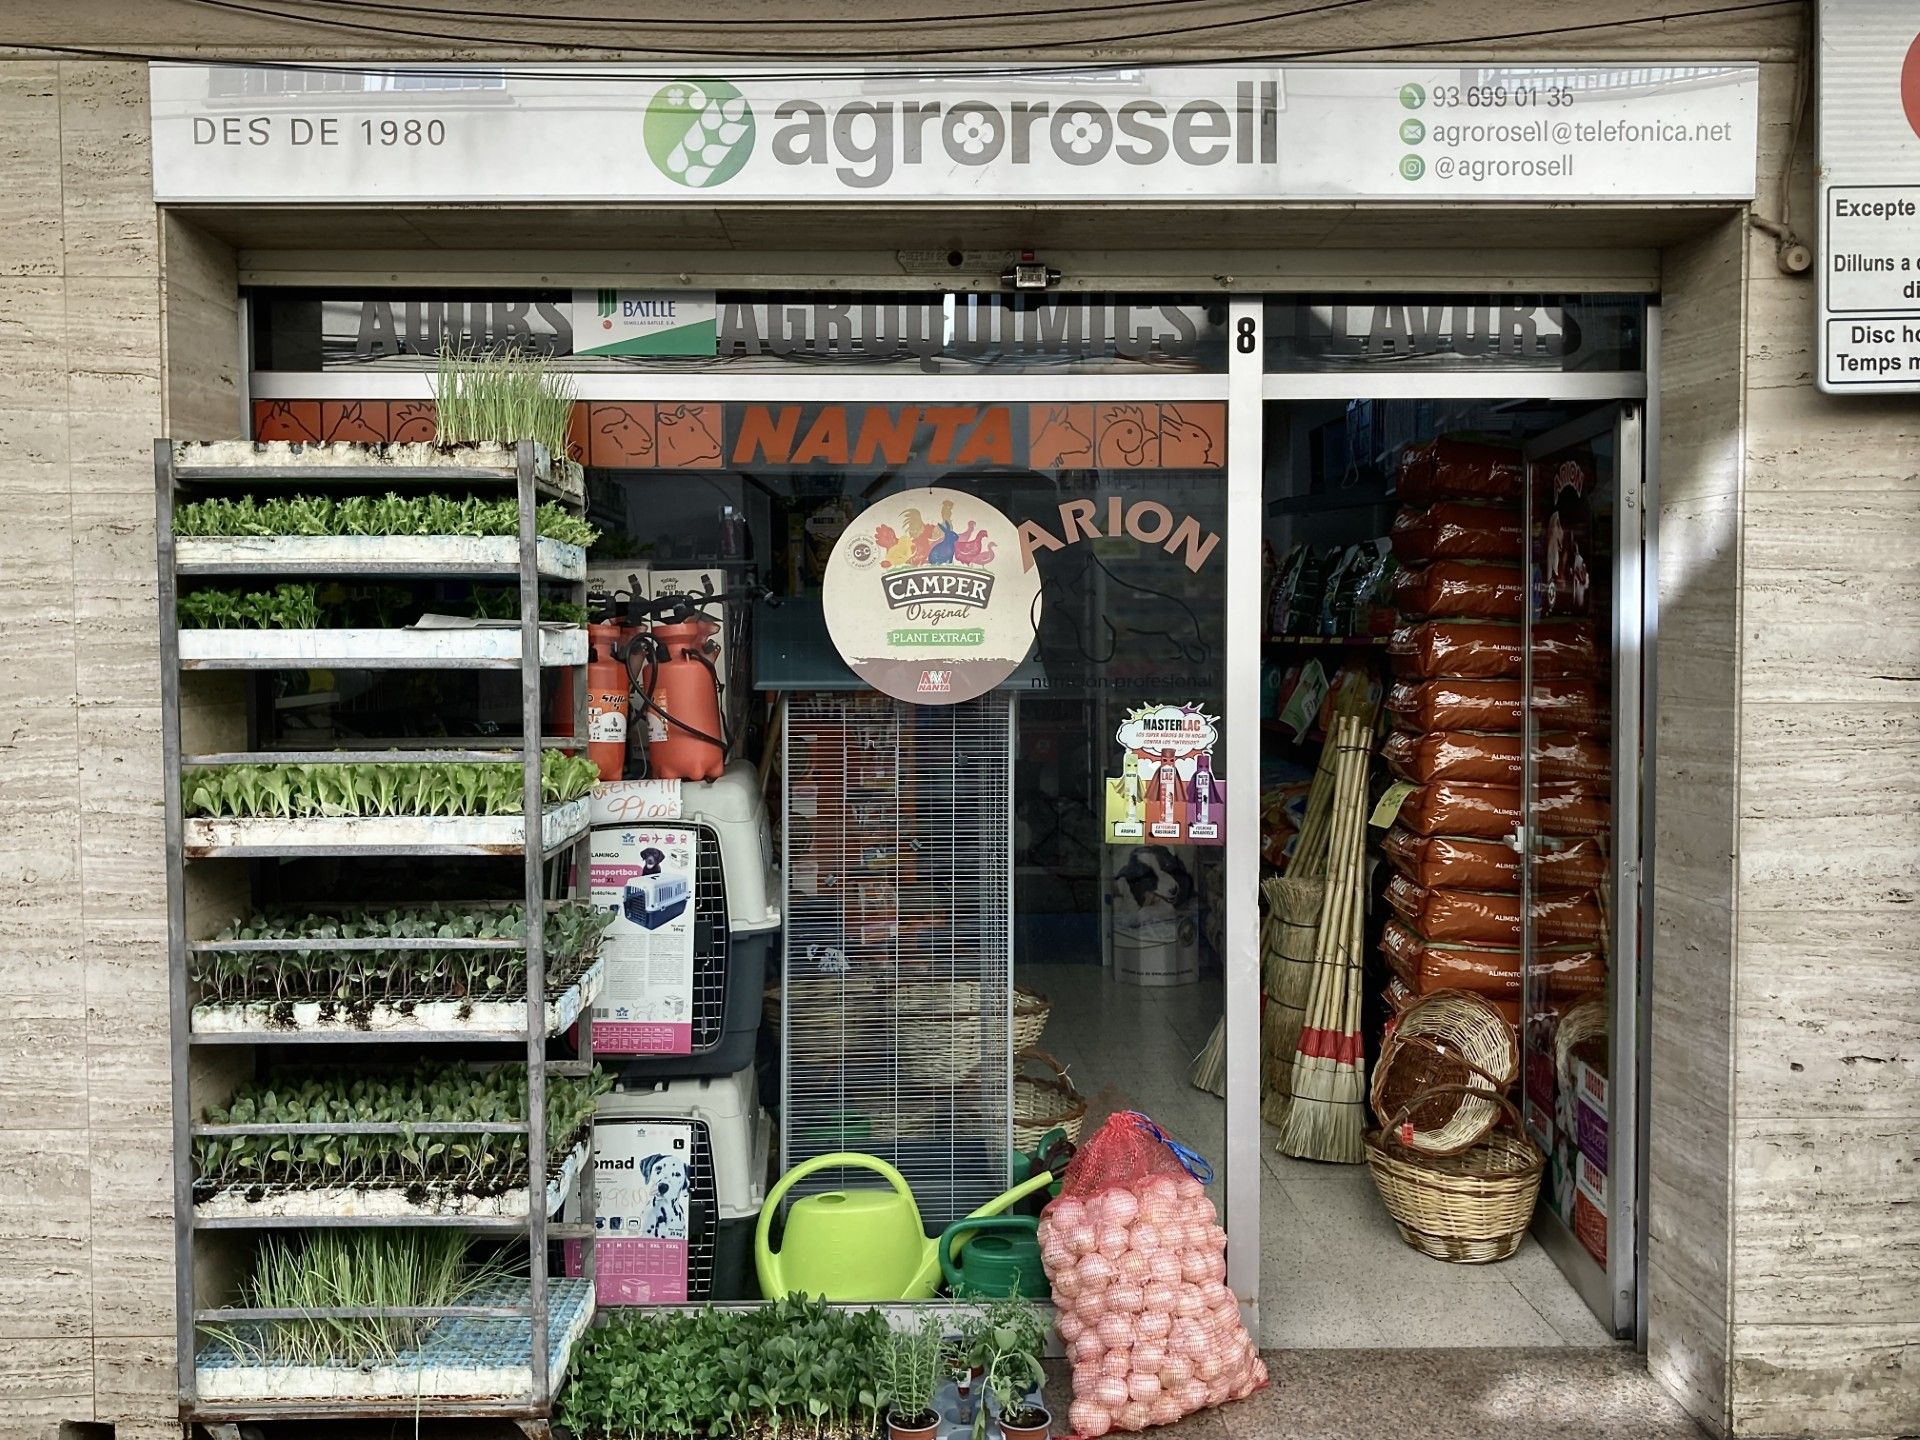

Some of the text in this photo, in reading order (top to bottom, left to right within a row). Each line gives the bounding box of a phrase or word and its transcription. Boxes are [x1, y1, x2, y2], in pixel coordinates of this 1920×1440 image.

[1432, 86, 1574, 108] 93 699 01 35
[193, 117, 447, 147] DES DE 1980
[771, 81, 1278, 189] agrorosell
[1432, 120, 1732, 147] agrorosell@telefonica.net
[1435, 154, 1573, 181] @agrorosell
[1835, 199, 1916, 221] Excepte
[1834, 254, 1895, 272] Dilluns
[1901, 258, 1911, 271] a
[623, 301, 676, 318] BATLLE
[1236, 316, 1257, 354] 8
[1851, 325, 1896, 344] Disc
[1836, 353, 1902, 375] Temps
[732, 407, 1014, 465] NANTA
[1017, 496, 1221, 574] ARION
[888, 575, 987, 601] CAMPER
[906, 603, 970, 626] Original
[892, 632, 981, 643] PLANT EXTRACT
[917, 684, 951, 692] NANTA
[1143, 719, 1201, 732] MASTERLAC
[591, 868, 638, 877] ansportbox
[594, 1157, 635, 1170] omad
